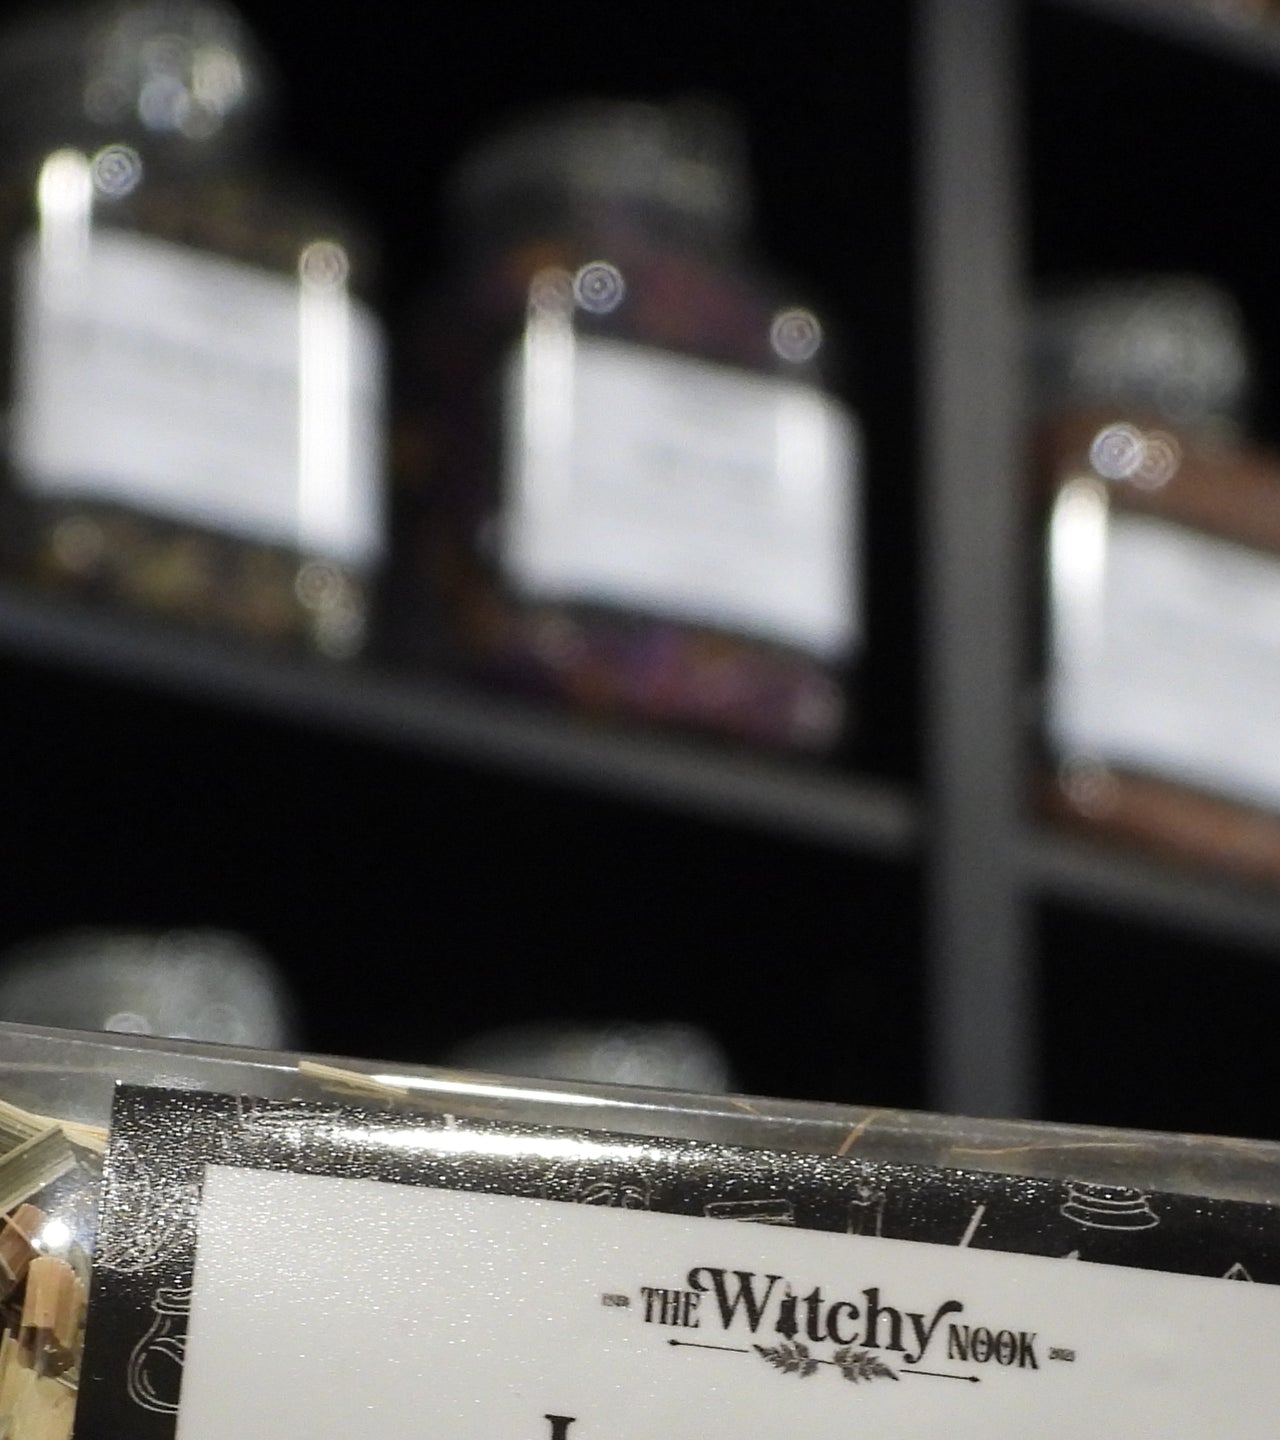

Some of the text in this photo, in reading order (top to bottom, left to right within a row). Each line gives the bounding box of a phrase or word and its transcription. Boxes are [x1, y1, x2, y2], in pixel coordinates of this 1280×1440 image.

[639, 1286, 702, 1329] THE
[686, 1266, 965, 1365] Witchy
[947, 1323, 1040, 1371] NOOK
